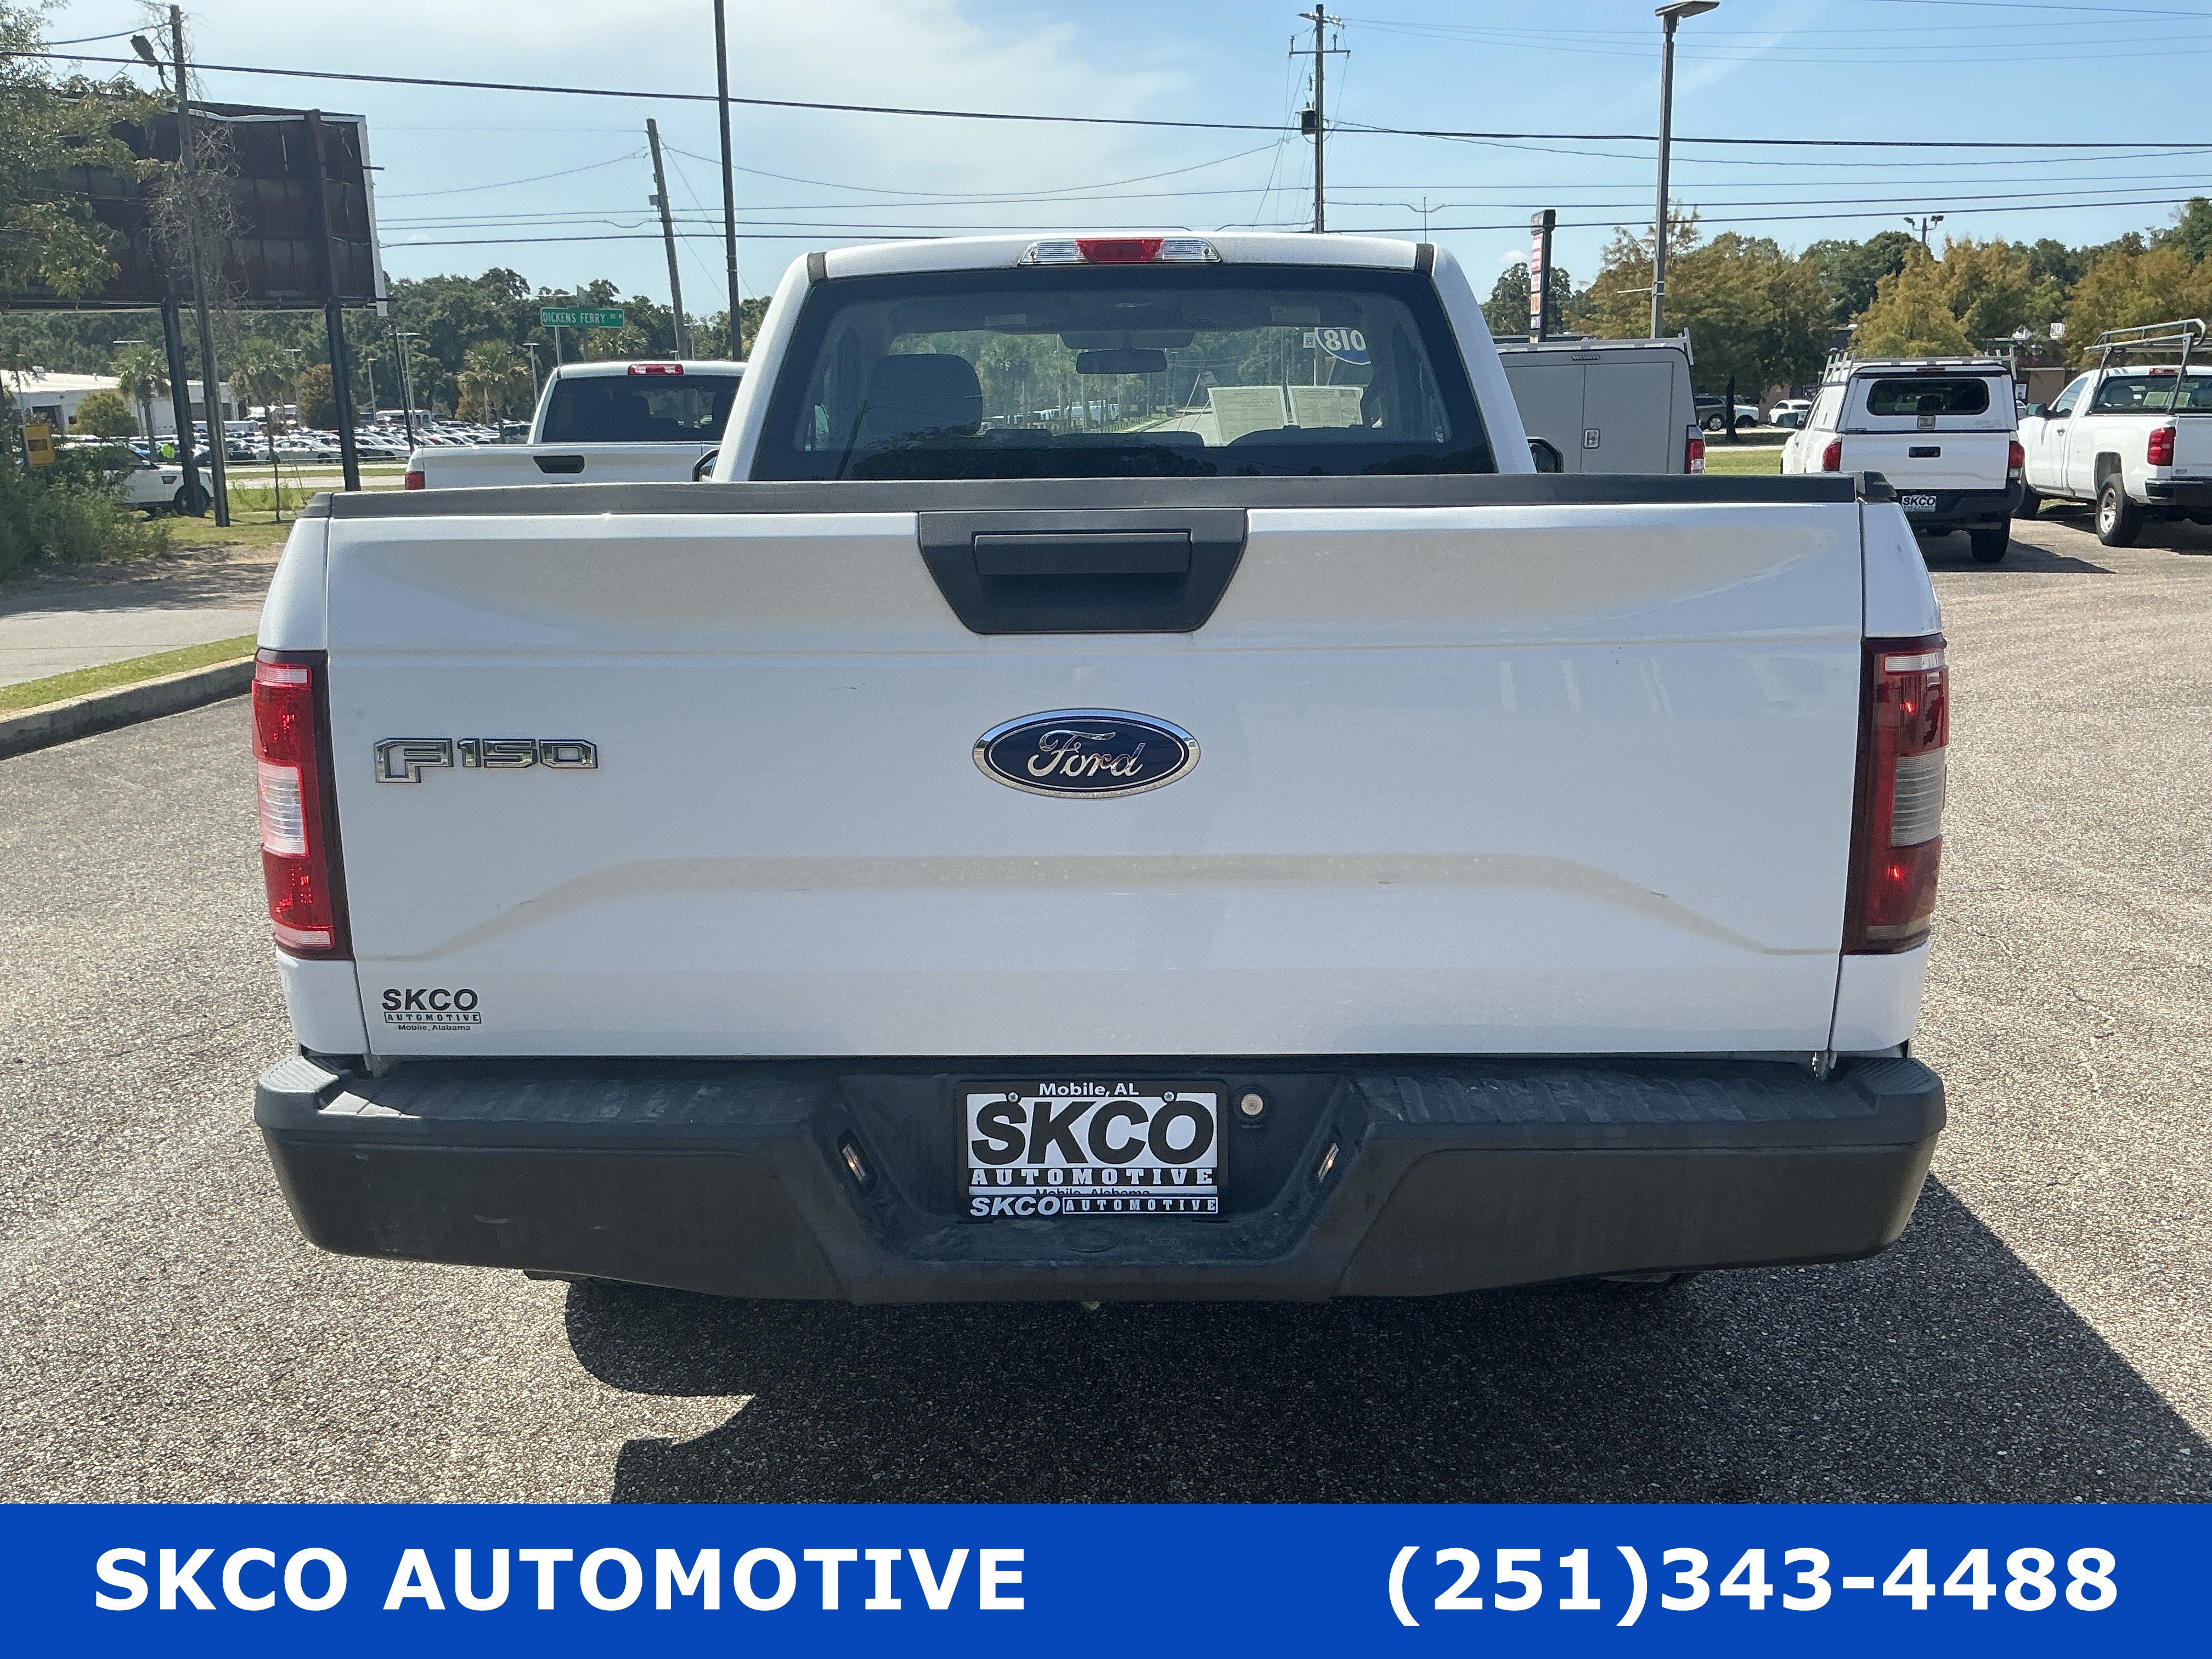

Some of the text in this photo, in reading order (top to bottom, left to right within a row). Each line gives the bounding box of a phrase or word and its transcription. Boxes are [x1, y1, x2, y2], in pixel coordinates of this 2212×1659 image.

[543, 312, 577, 324] DICKENS
[580, 313, 605, 324] FERRY
[1903, 496, 1935, 505] SKCO
[1027, 729, 1146, 777] Ford
[382, 989, 478, 1011] SKCO
[1039, 1082, 1139, 1097] Mobile, AL
[971, 1099, 1214, 1165] SKCO
[971, 1168, 1213, 1186] AUTOMOTIVE
[969, 1195, 1216, 1216] SKCO AUTOMOTIVE
